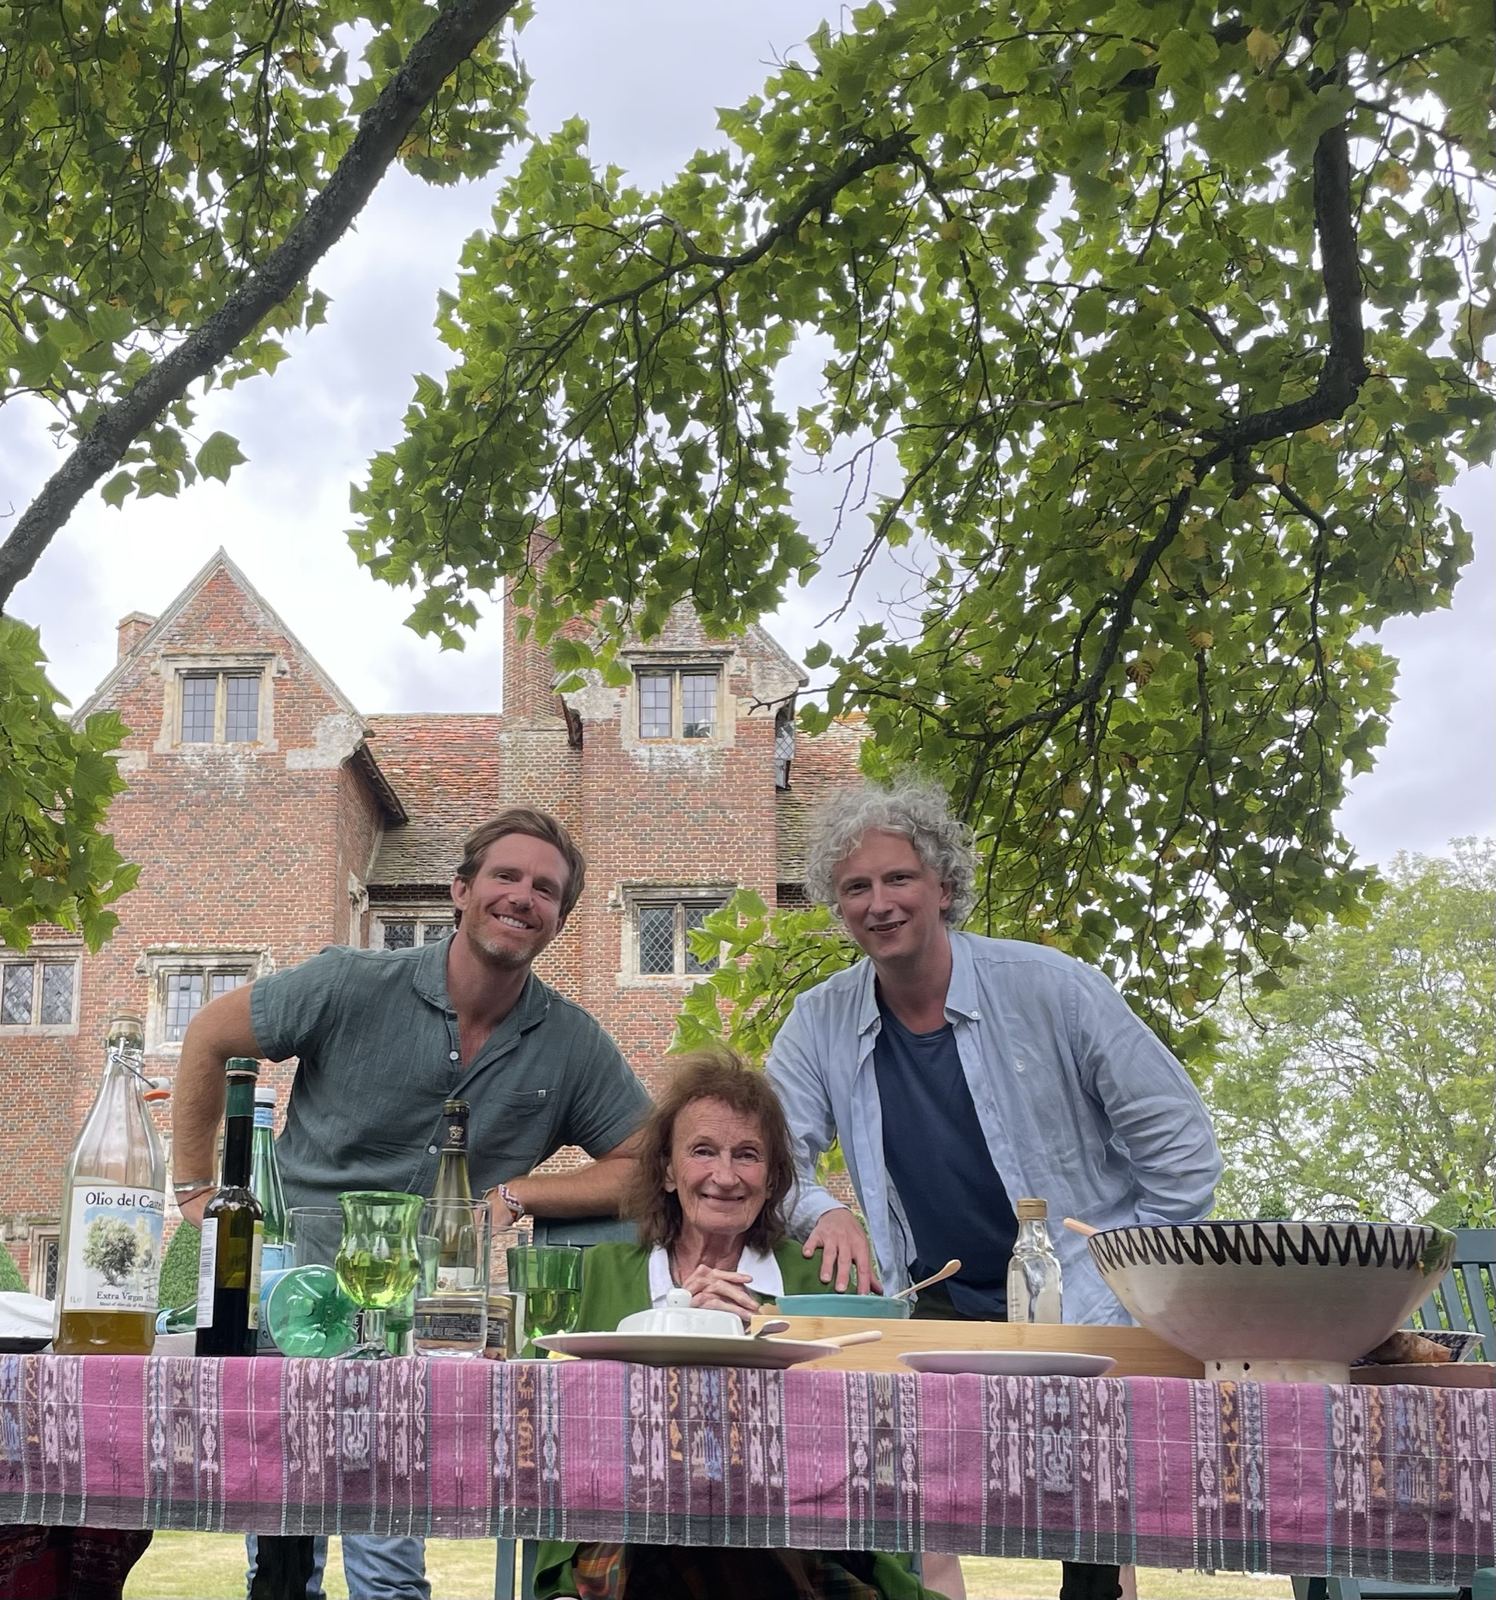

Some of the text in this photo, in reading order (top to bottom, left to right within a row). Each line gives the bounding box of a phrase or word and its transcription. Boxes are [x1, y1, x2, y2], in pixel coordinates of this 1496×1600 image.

[85, 1191, 113, 1206] Olio
[117, 1193, 136, 1207] del
[96, 1291, 120, 1300] Extra
